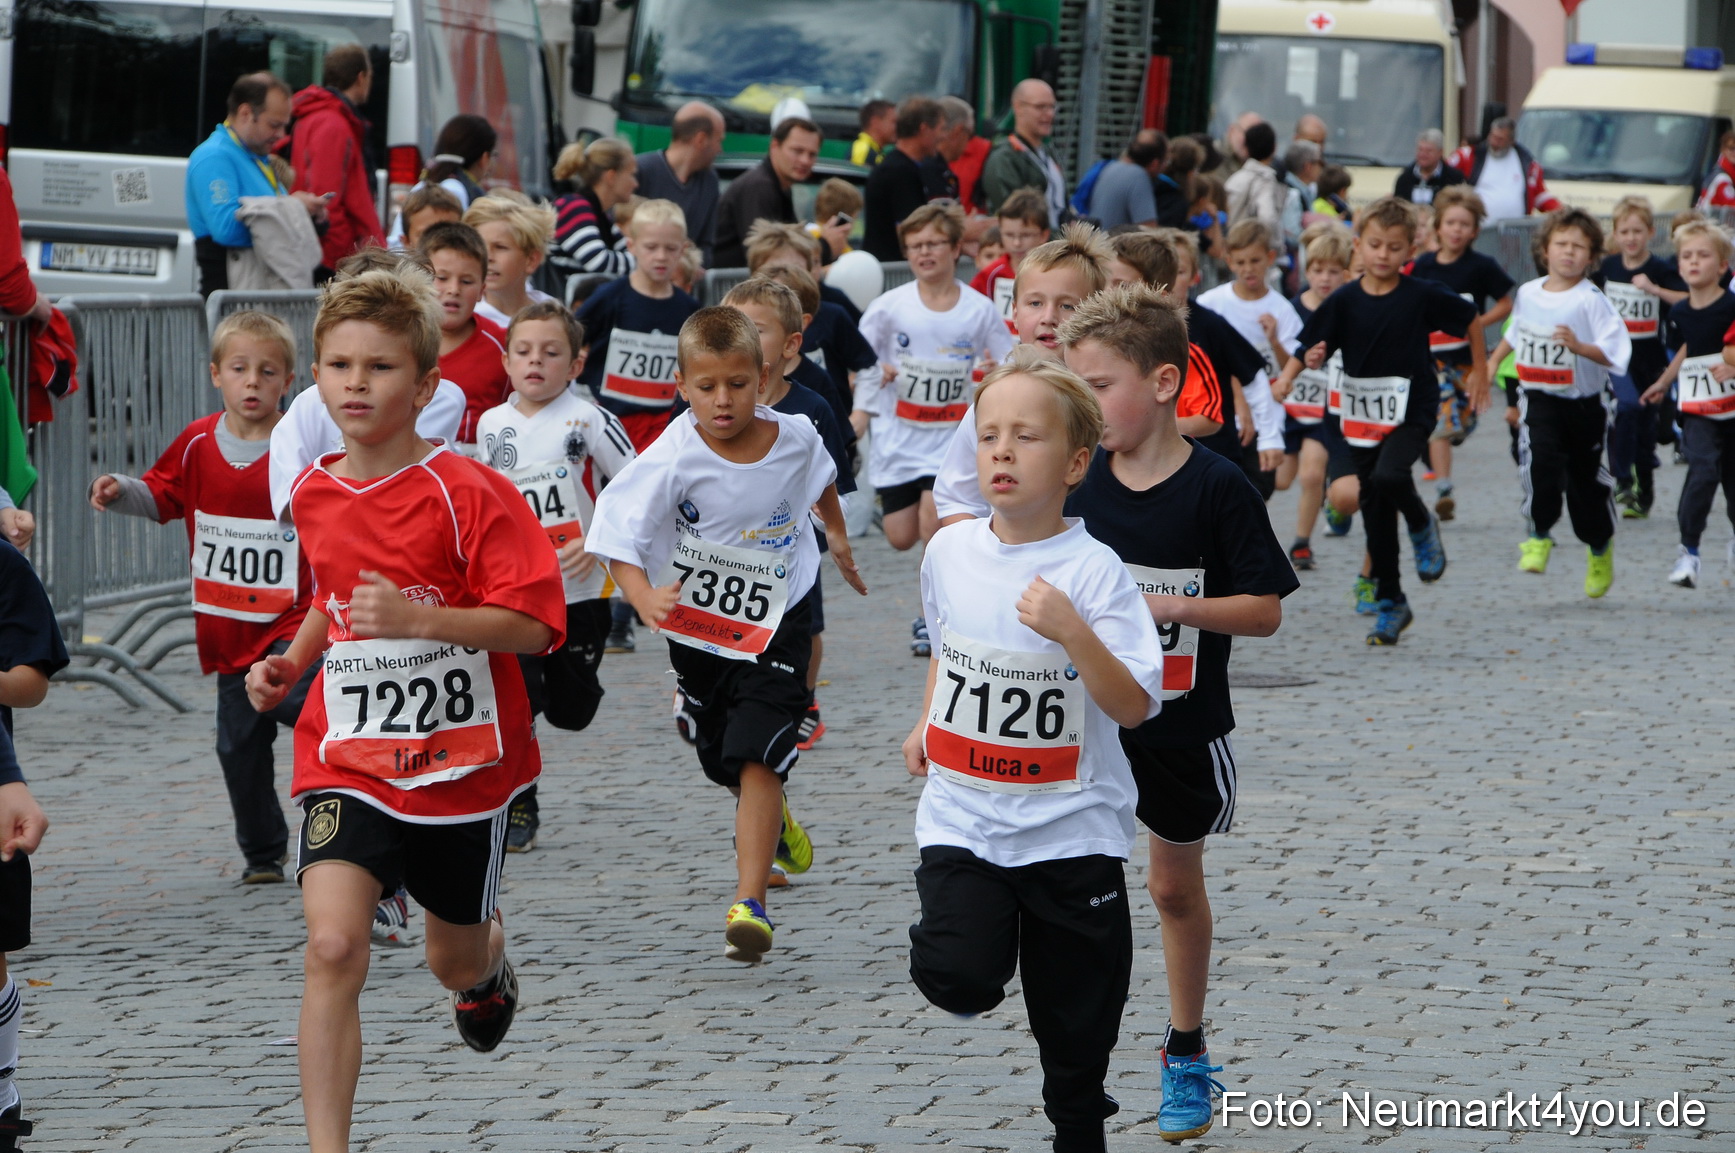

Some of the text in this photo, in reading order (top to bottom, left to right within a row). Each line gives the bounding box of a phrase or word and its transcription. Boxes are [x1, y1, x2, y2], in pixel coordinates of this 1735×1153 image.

[112, 250, 152, 268] 1111
[619, 350, 677, 380] 7307
[1521, 338, 1565, 365] 7112
[907, 374, 964, 402] 7105
[1295, 382, 1320, 403] 32
[1688, 373, 1735, 397] 71
[1346, 394, 1396, 421] 7119
[523, 485, 565, 520] 04
[224, 528, 278, 541] Neumarkt
[202, 541, 283, 585] 7400
[708, 554, 770, 576] Neumarkt
[402, 588, 424, 598] TSV
[672, 561, 772, 622] 7385
[1136, 582, 1176, 595] markt
[670, 609, 733, 640] Benedikt
[327, 644, 456, 675] PARTL Neumarkt
[703, 643, 719, 654] 2006
[941, 642, 1058, 681] PARTL Neumarkt
[341, 668, 474, 734] 7228
[944, 669, 1065, 740] 7126
[481, 710, 491, 721] M
[1068, 733, 1077, 743] M
[394, 748, 430, 772] tim
[969, 747, 1021, 776] Luca
[1101, 890, 1118, 903] JAKO
